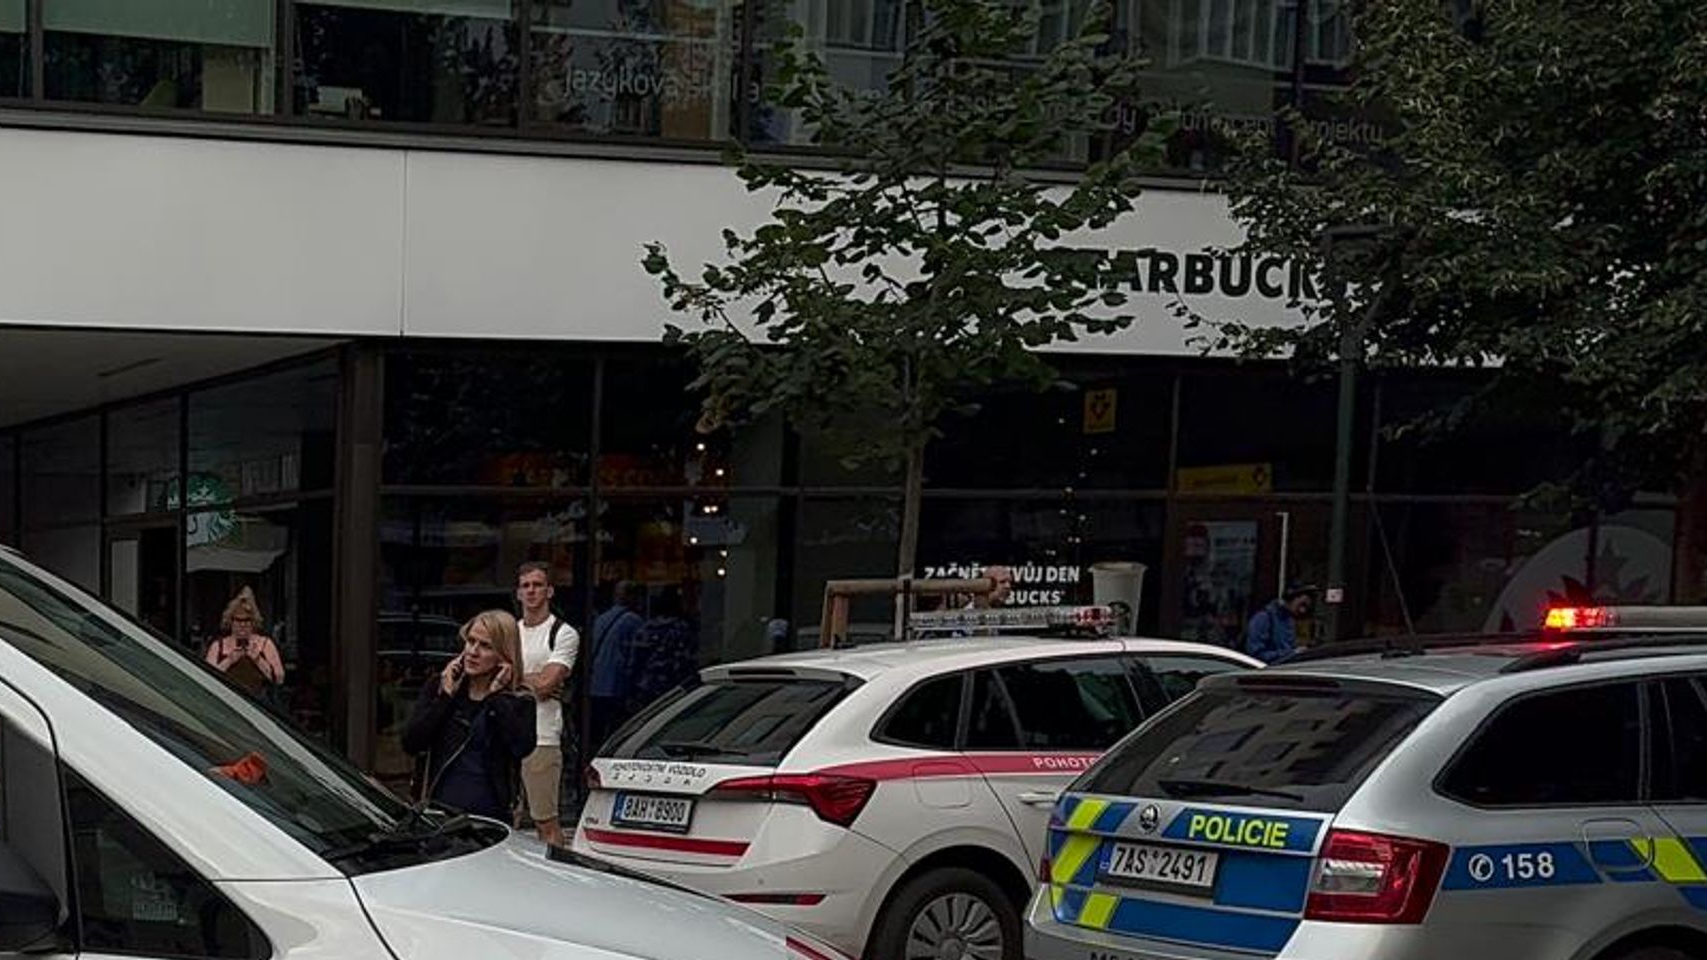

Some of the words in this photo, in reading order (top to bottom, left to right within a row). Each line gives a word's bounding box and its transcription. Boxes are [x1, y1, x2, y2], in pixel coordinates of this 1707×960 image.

[1046, 566, 1080, 582] DEN
[1188, 814, 1290, 848] POLICIE
[1112, 846, 1148, 874] 7AS
[1158, 851, 1207, 882] 2491
[1501, 852, 1555, 880] 158
